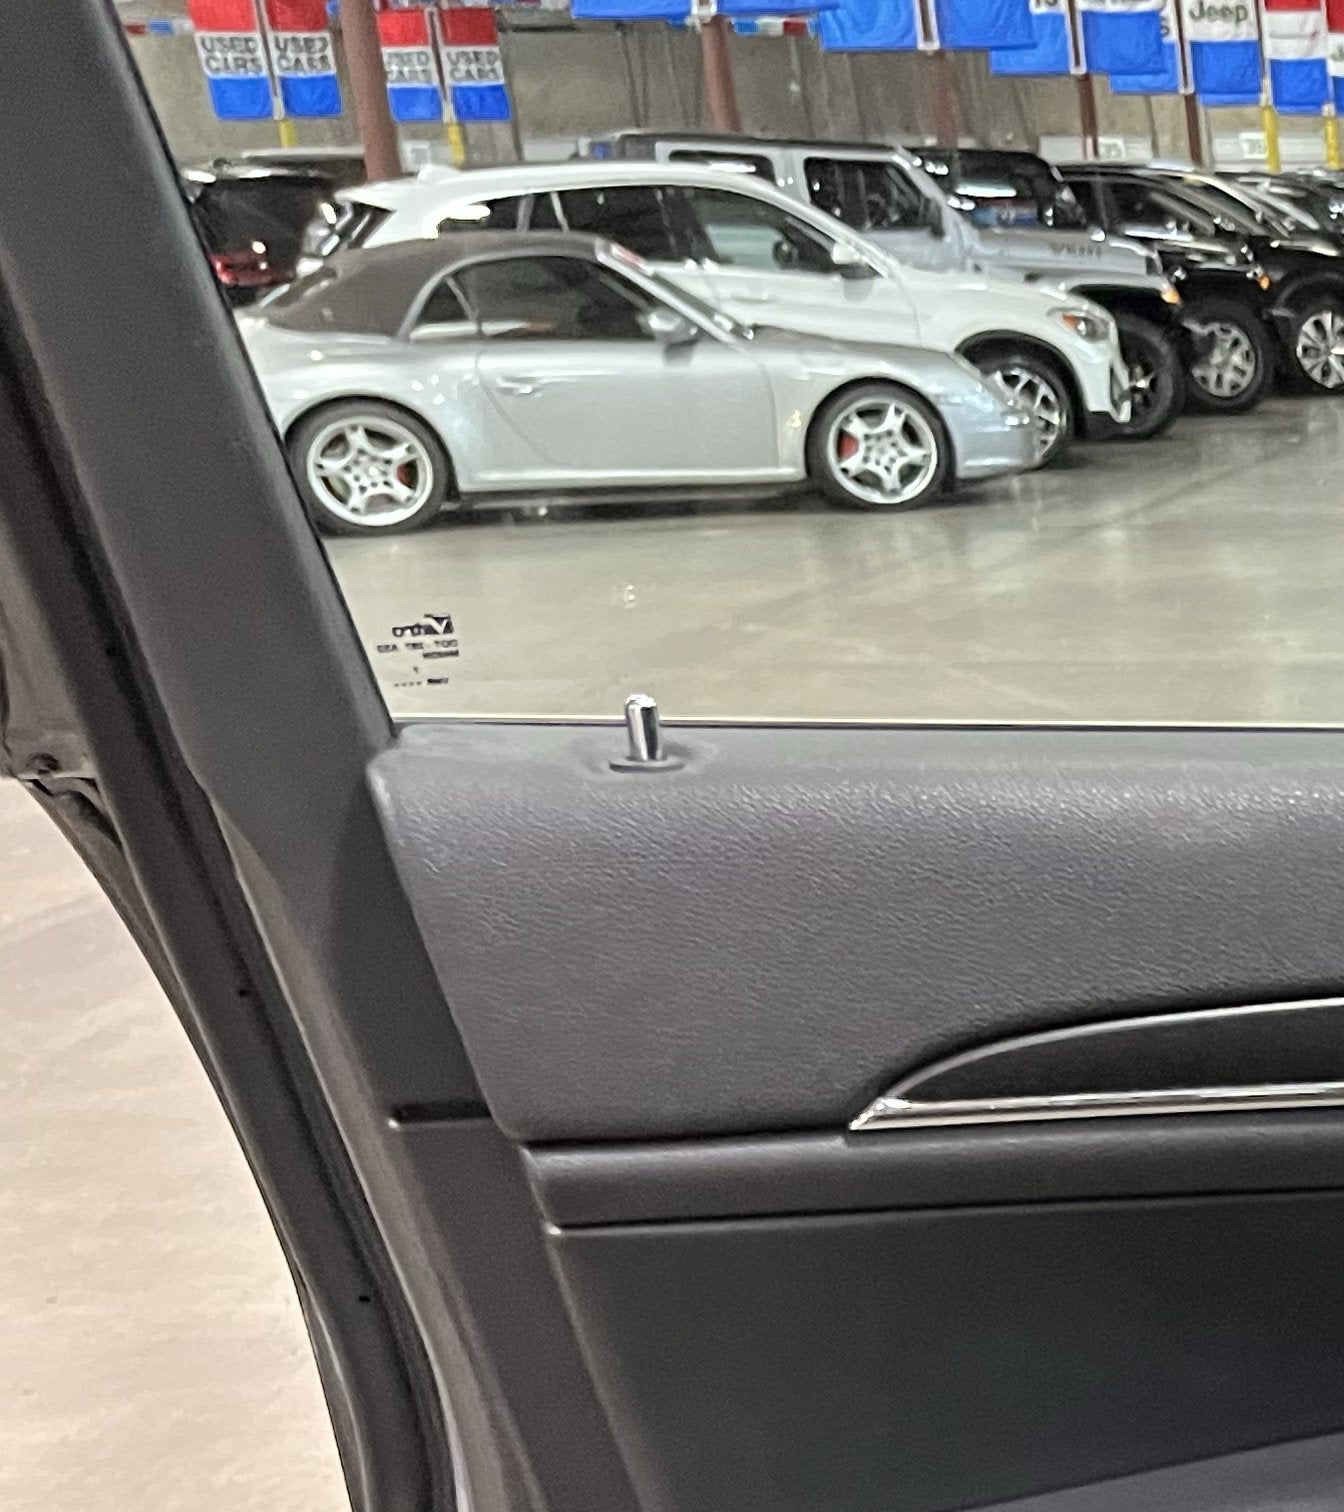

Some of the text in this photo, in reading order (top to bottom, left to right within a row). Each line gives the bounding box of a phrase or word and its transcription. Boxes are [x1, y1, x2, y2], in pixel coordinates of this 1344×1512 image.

[1189, 0, 1249, 24] Jeep
[200, 36, 258, 54] USED
[273, 36, 329, 54] USED
[204, 55, 263, 72] CARS
[277, 54, 332, 72] CARS
[446, 50, 500, 66] USED
